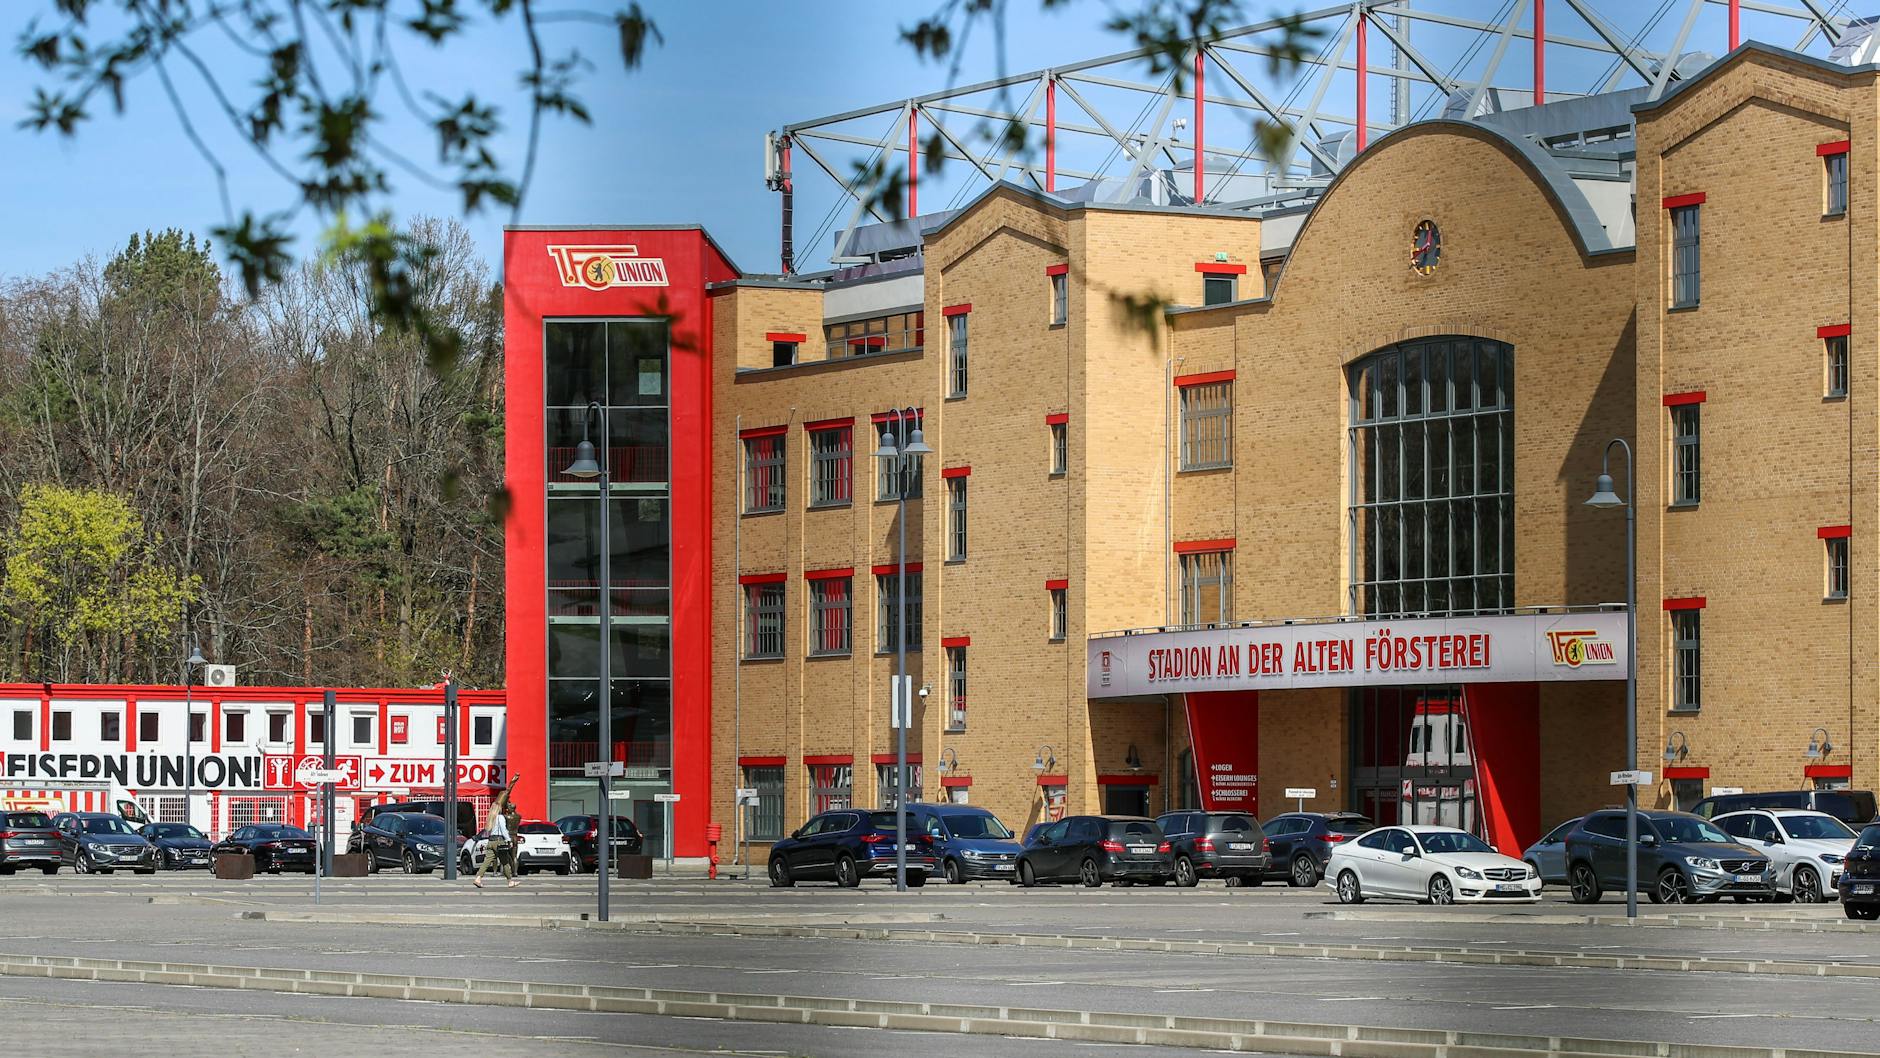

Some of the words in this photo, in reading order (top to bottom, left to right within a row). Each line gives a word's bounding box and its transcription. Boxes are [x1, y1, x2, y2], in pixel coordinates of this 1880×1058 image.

[615, 262, 664, 282] UNION
[1148, 646, 1212, 680] STADION
[1217, 644, 1241, 677] AN
[1248, 642, 1284, 676] DER
[1292, 639, 1354, 674] ALTEN
[1365, 627, 1491, 671] FÖRSTEREI
[1584, 643, 1614, 660] UNION
[136, 755, 261, 788] UNION!
[389, 763, 435, 784] ZUM
